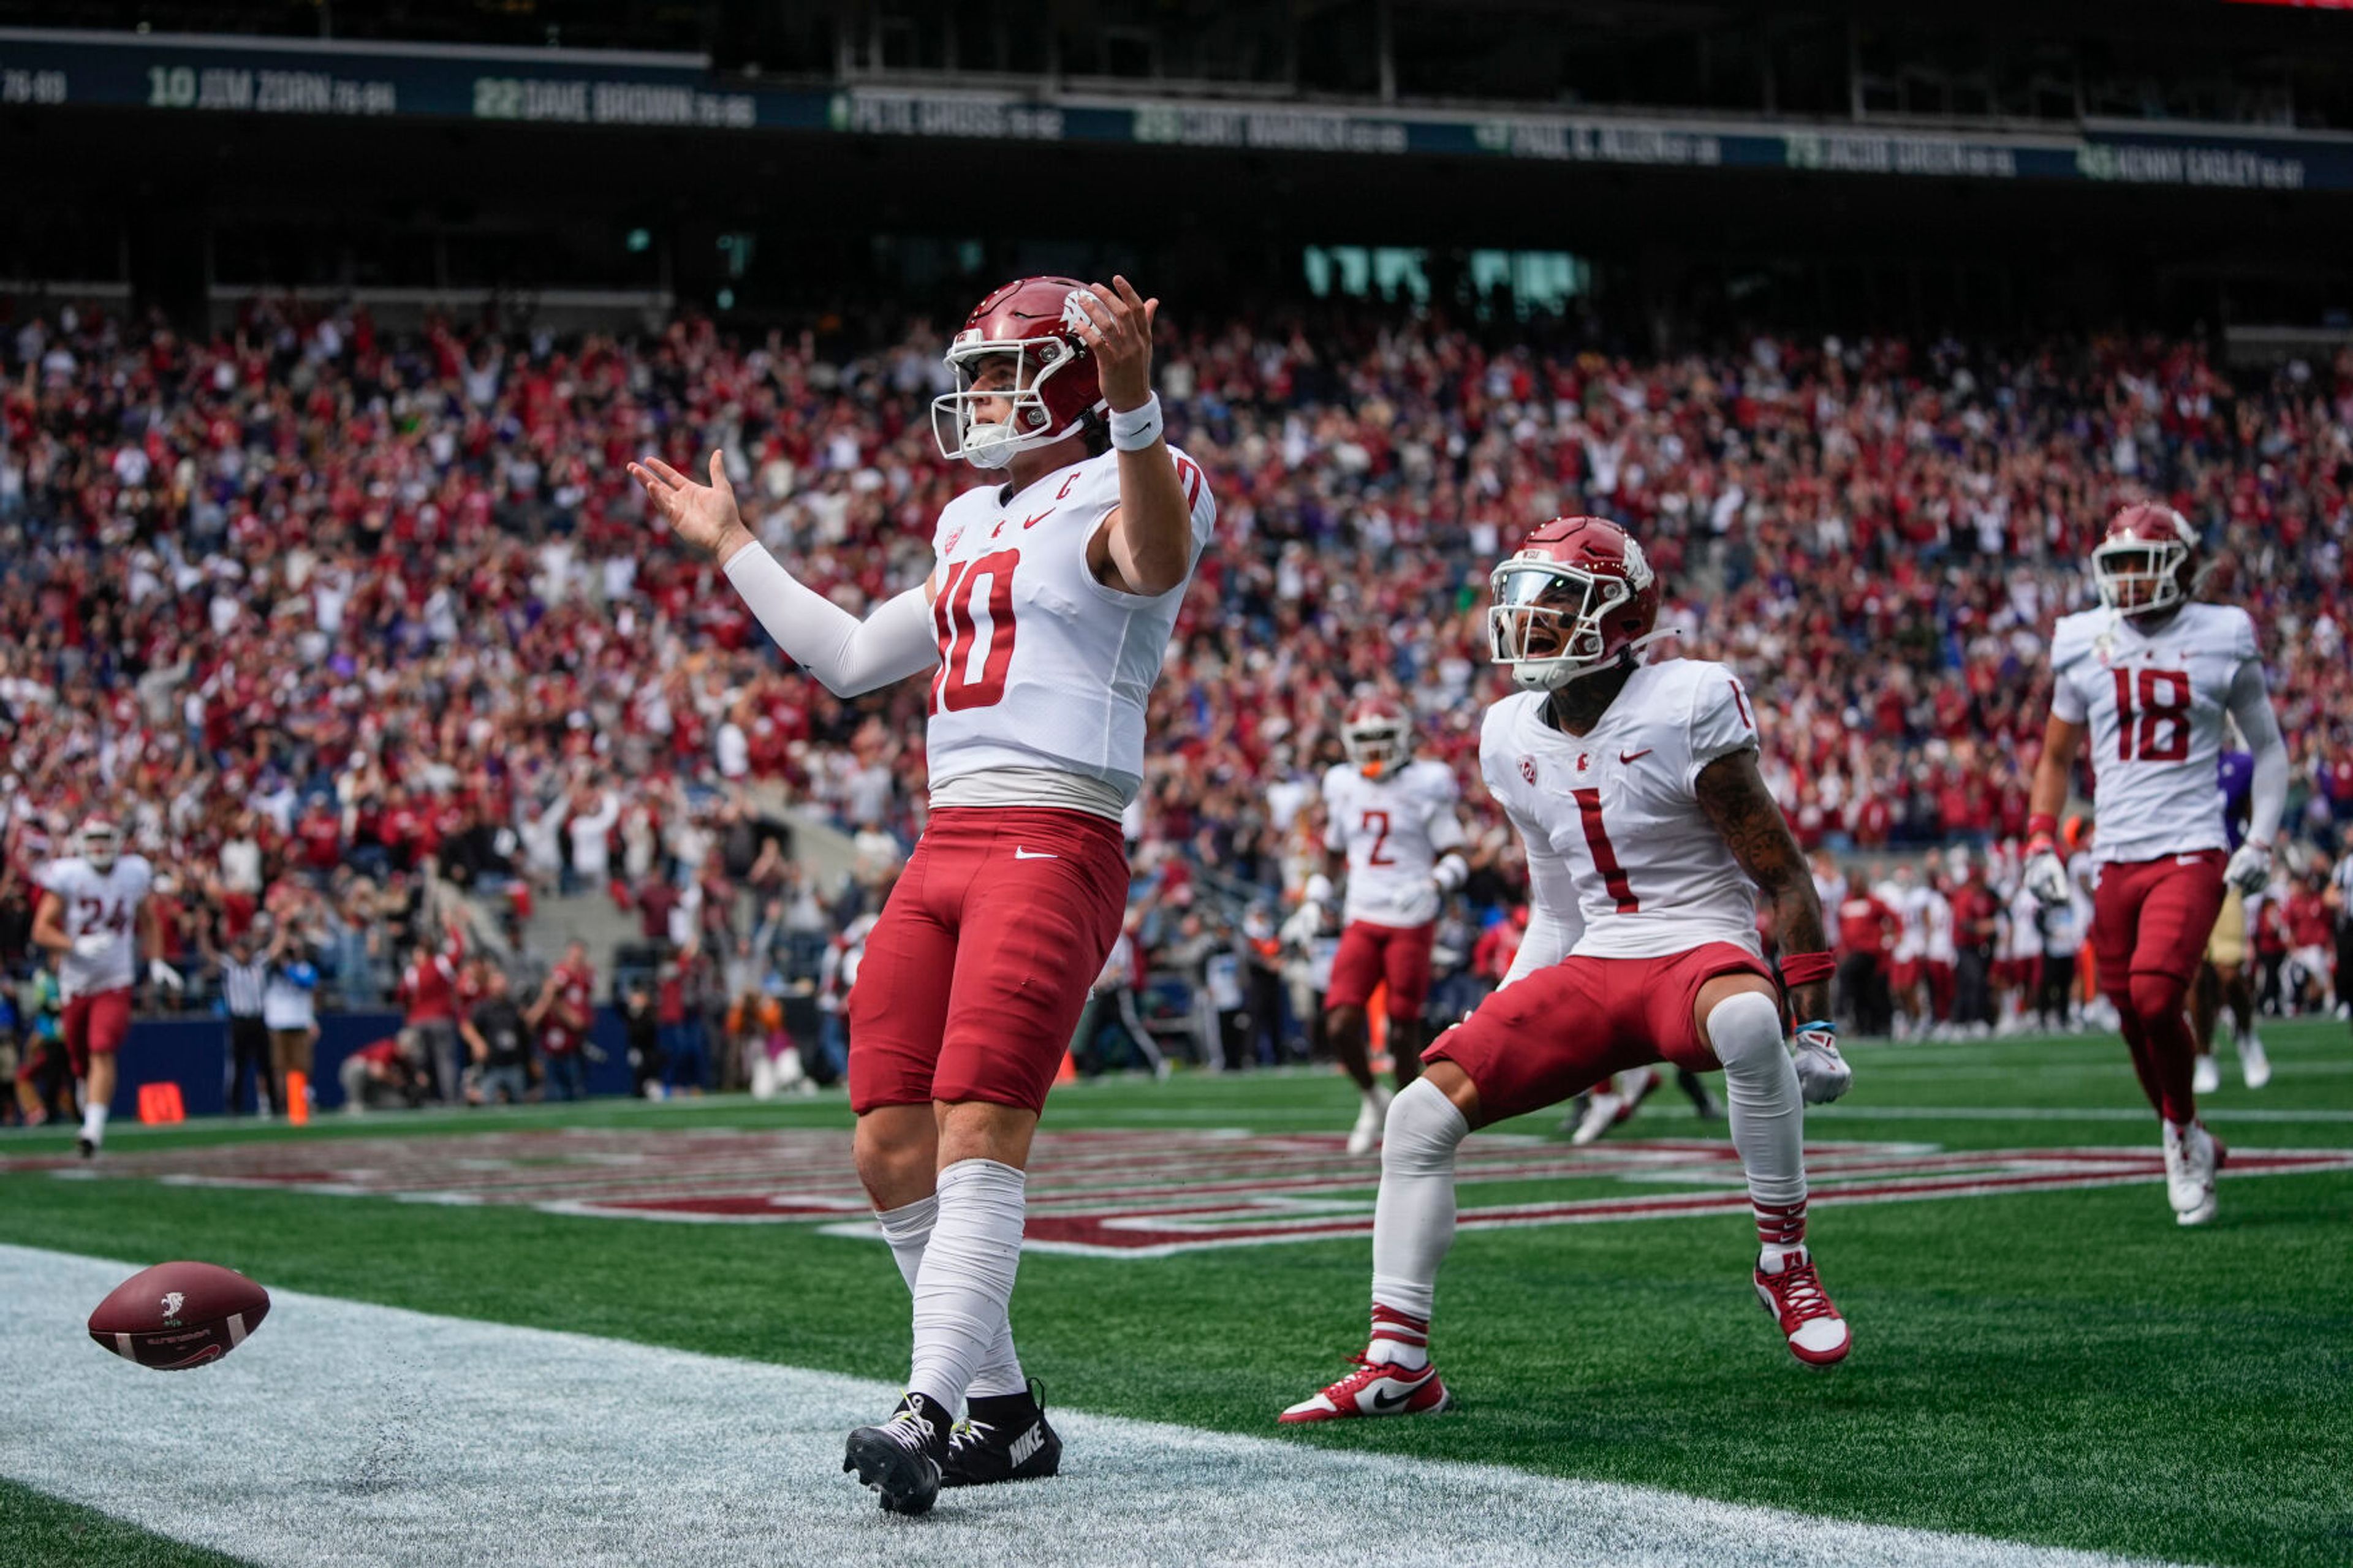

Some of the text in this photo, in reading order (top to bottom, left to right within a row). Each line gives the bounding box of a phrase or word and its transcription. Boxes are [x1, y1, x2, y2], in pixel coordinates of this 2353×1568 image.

[148, 67, 196, 107] 10
[256, 70, 331, 114] ZORN
[472, 77, 521, 118] 22
[522, 78, 588, 122] DAVE
[592, 81, 694, 126] BROWN
[1055, 471, 1081, 501] C
[928, 548, 1020, 716] 10
[1728, 680, 1752, 729] 1
[2111, 667, 2191, 761] 18
[1362, 810, 1395, 866] 2
[1571, 787, 1639, 914] 1
[78, 898, 127, 937] 24
[1009, 1419, 1045, 1469] NIKE
